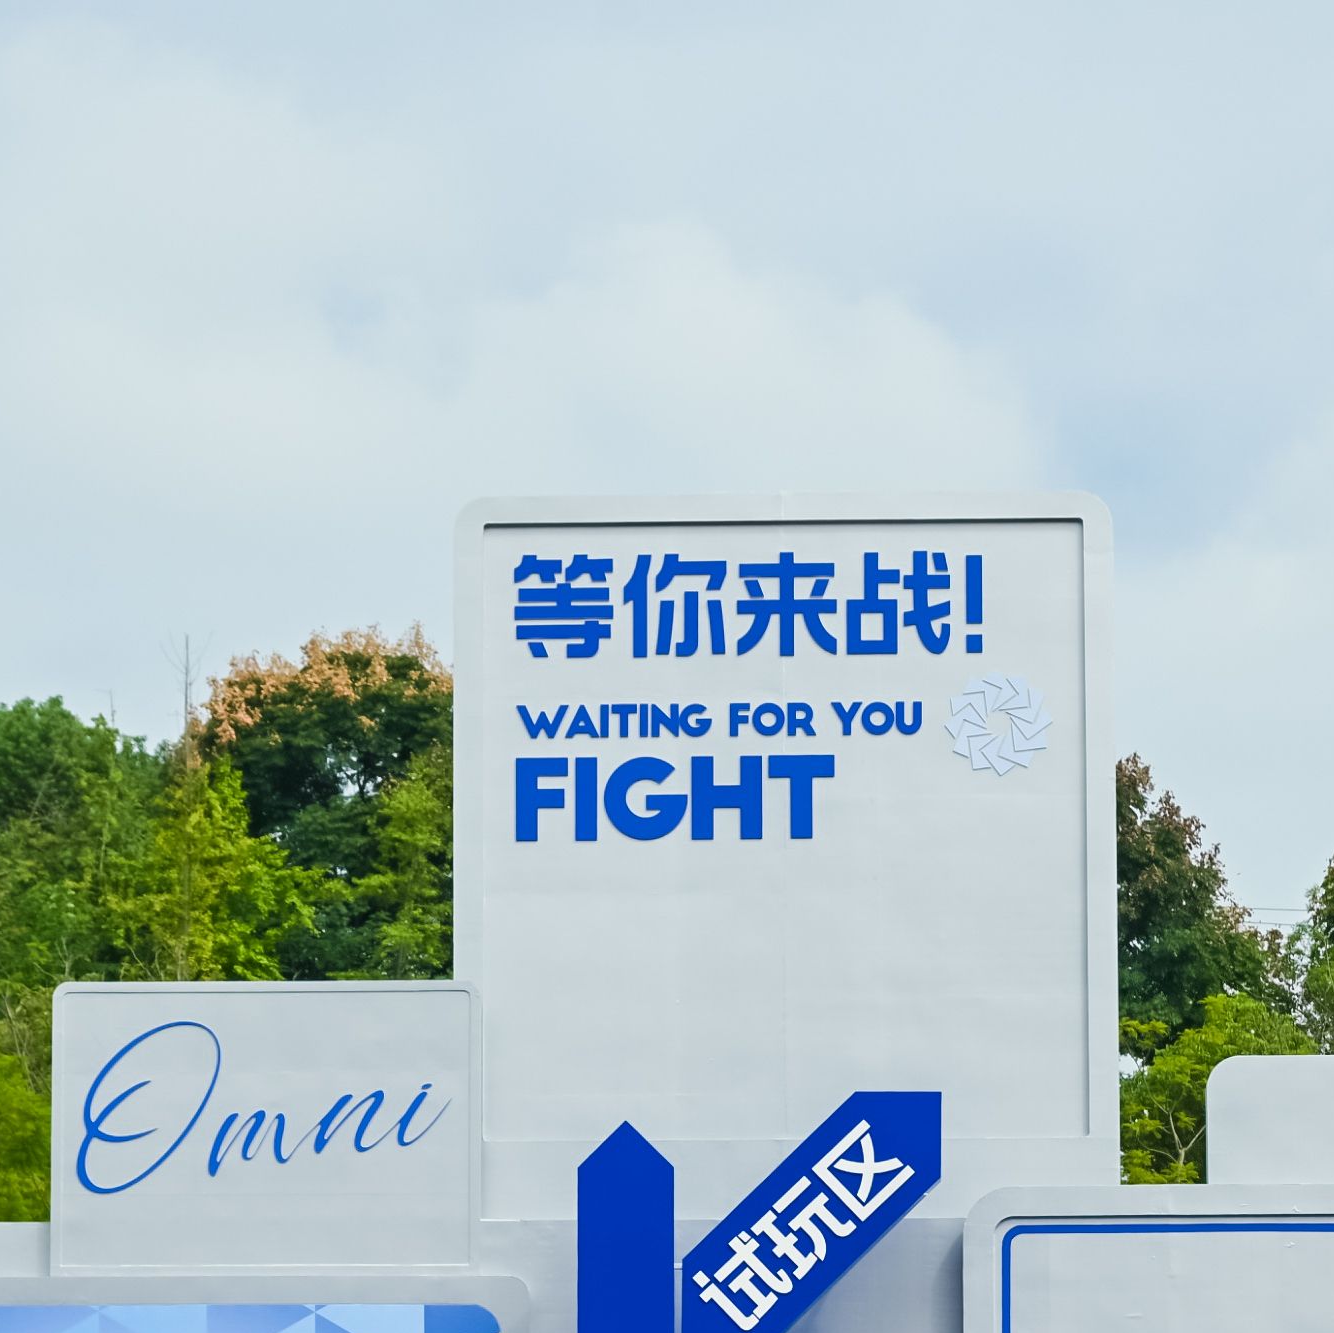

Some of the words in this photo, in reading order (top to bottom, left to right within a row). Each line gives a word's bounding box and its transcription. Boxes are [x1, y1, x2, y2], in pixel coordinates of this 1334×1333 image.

[513, 550, 984, 659] 等你来战!
[516, 703, 713, 739] WAITING
[729, 702, 816, 738] FOR
[831, 701, 923, 736] YOU
[514, 754, 835, 842] FIGHT
[76, 1020, 453, 1195] Omni
[692, 1119, 915, 1331] 试玩区
